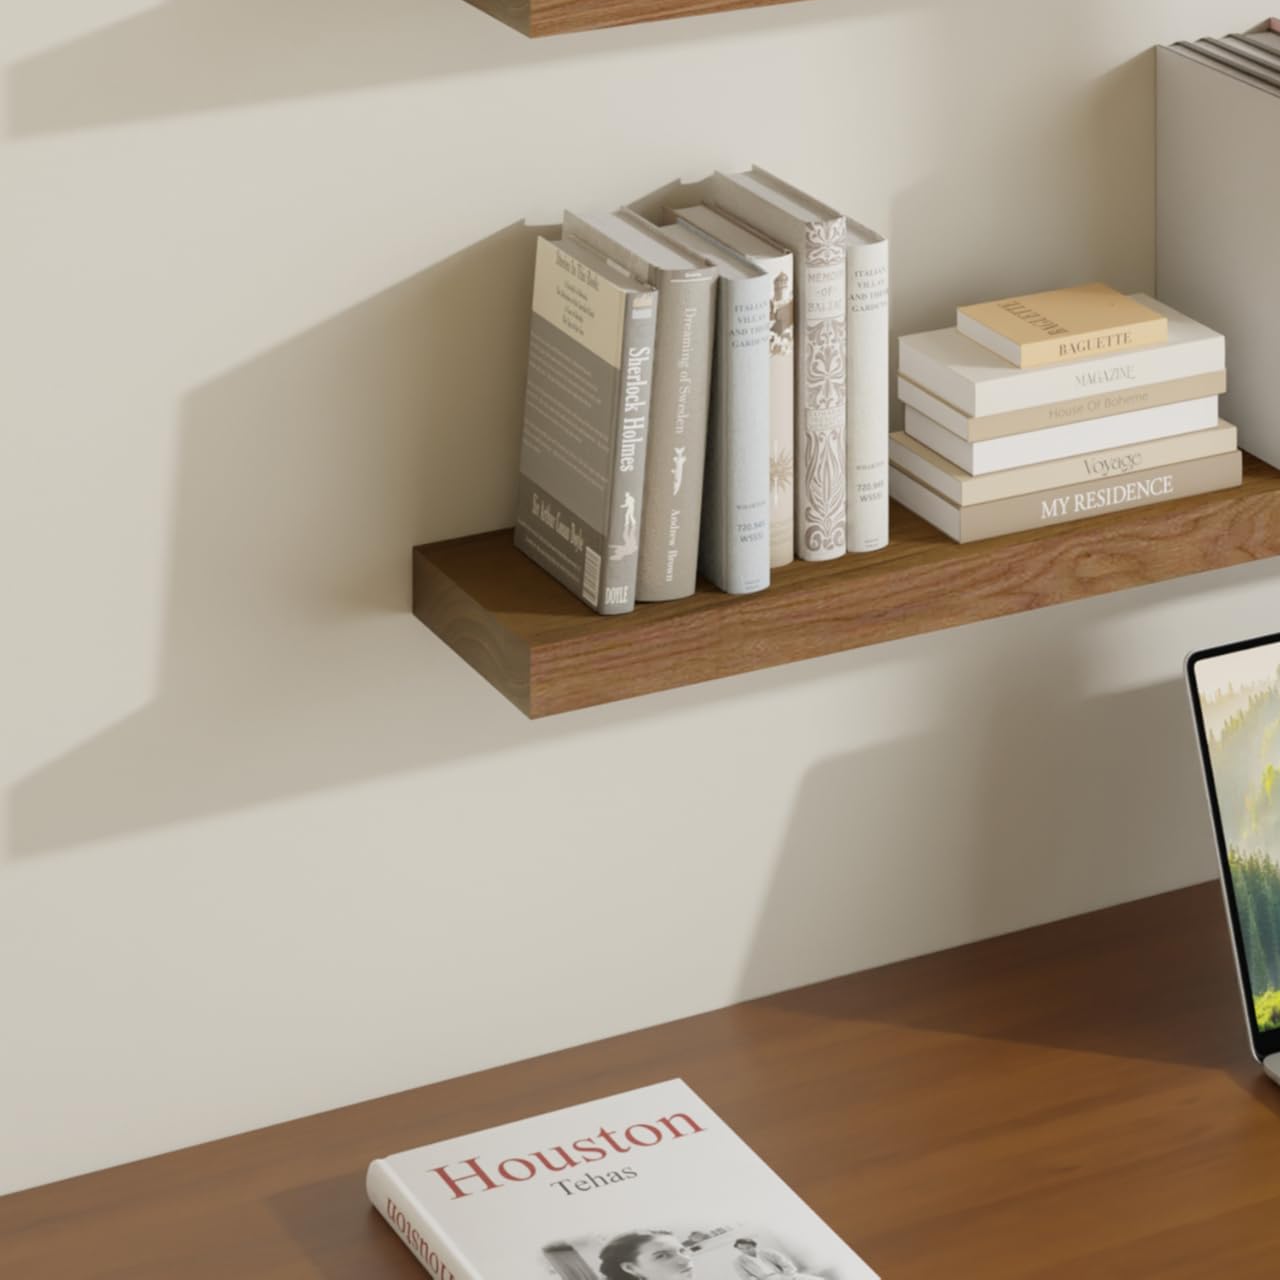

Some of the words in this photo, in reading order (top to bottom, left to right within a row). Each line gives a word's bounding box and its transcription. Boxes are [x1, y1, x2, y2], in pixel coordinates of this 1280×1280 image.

[998, 300, 1068, 336] BAGUETTE
[679, 308, 696, 368] Dreaming
[1059, 332, 1132, 357] BAGUETTE
[624, 347, 650, 412] Sherlock
[680, 371, 692, 382] of
[1074, 365, 1135, 388] MAGAZINE
[675, 387, 689, 434] Sweden
[1049, 405, 1083, 420] House
[1087, 401, 1102, 413] Of
[1104, 391, 1148, 409] Boheme
[619, 417, 645, 472] Holmes
[1083, 452, 1143, 477] Voyage
[1041, 498, 1070, 519] MY
[1074, 475, 1174, 513] RESIDENCE
[667, 509, 680, 547] Andrew
[665, 550, 678, 582] Brown
[428, 1111, 707, 1200] Houston
[550, 1163, 638, 1196] Tehas
